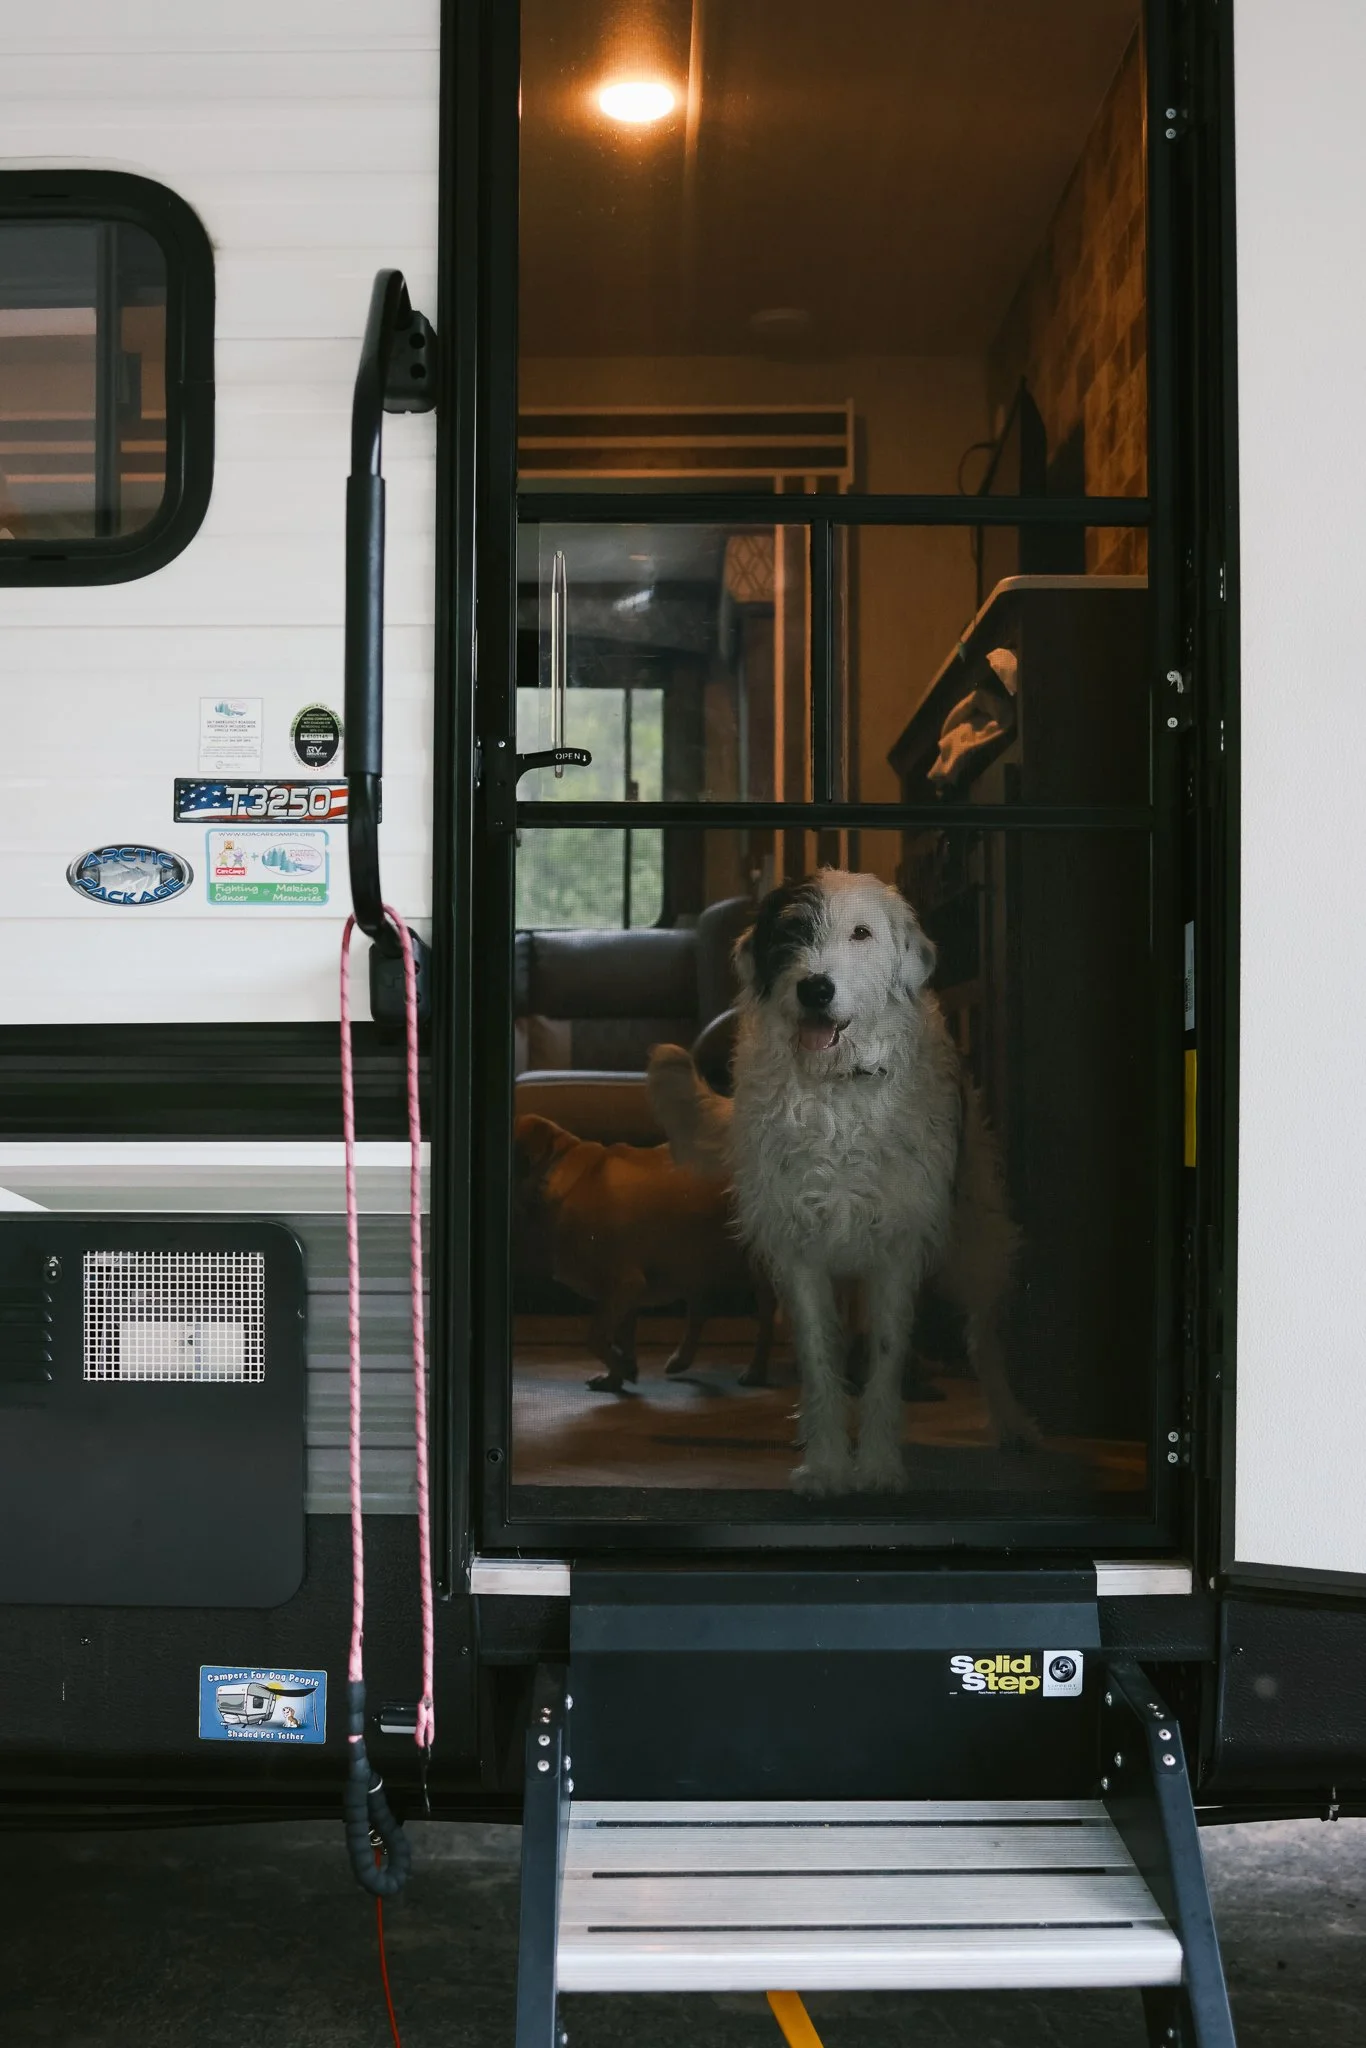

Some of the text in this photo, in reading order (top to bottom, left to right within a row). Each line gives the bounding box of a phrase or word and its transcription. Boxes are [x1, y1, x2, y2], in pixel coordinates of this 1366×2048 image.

[225, 787, 332, 817] T3250
[81, 847, 176, 869] ARCTIC
[75, 876, 185, 904] PACKAGE
[214, 894, 322, 902] Cancer Memories
[215, 884, 259, 894] Fighting
[275, 884, 319, 894] Making
[949, 1654, 1032, 1674] Solid
[207, 1671, 319, 1687] Campers For Dog People
[961, 1672, 1040, 1695] Step
[227, 1730, 304, 1740] Shaded Pet Tether
